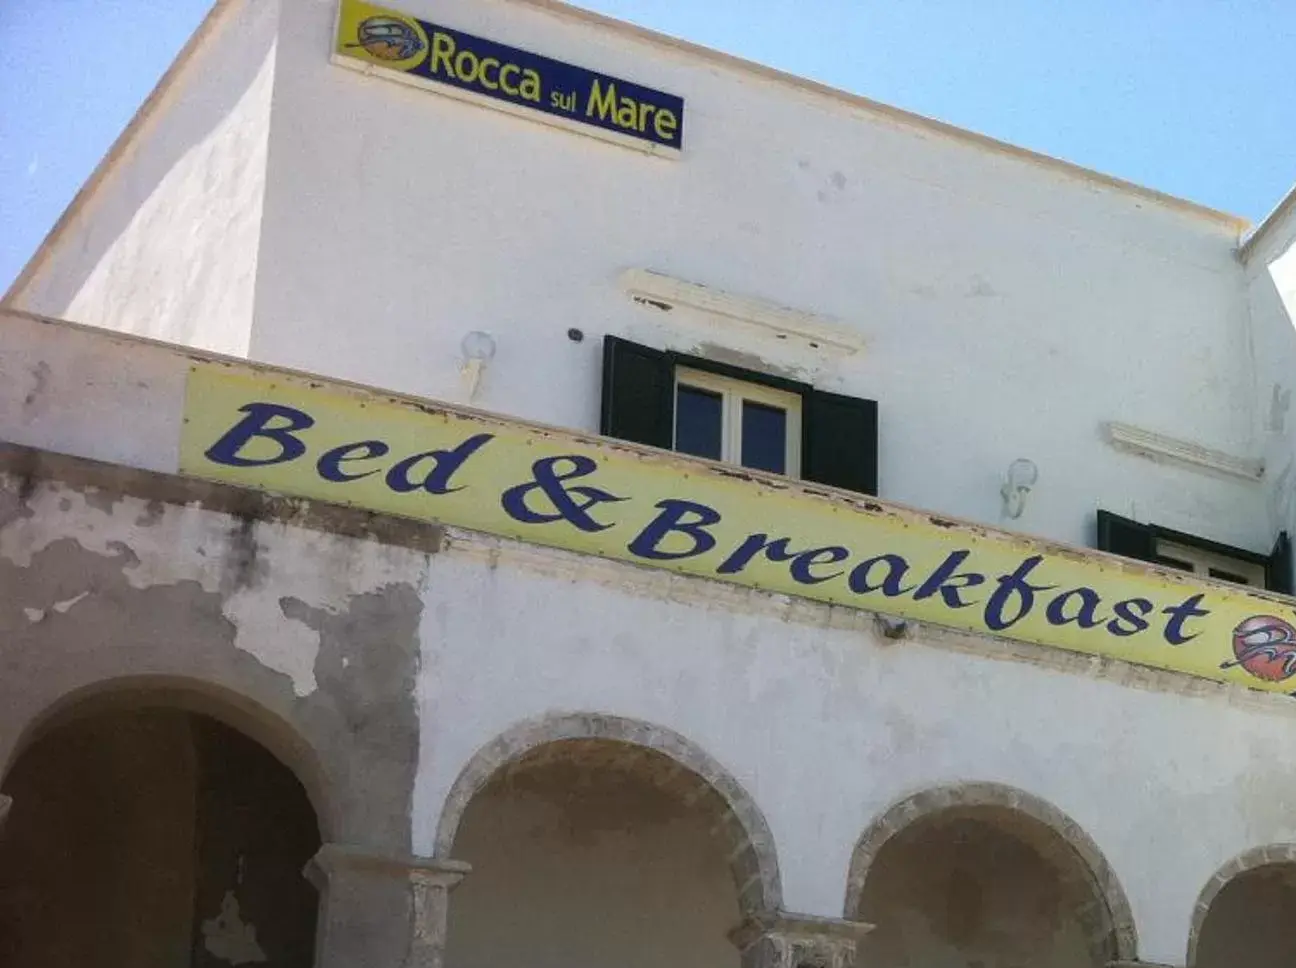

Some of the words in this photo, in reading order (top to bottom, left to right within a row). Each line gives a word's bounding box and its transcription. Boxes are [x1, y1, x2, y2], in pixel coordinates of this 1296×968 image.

[430, 31, 541, 102] Rocca
[550, 87, 577, 113] sul
[587, 79, 677, 140] Mare
[204, 402, 494, 495] Bed
[501, 455, 632, 532] &
[627, 499, 1210, 646] Breakfast
